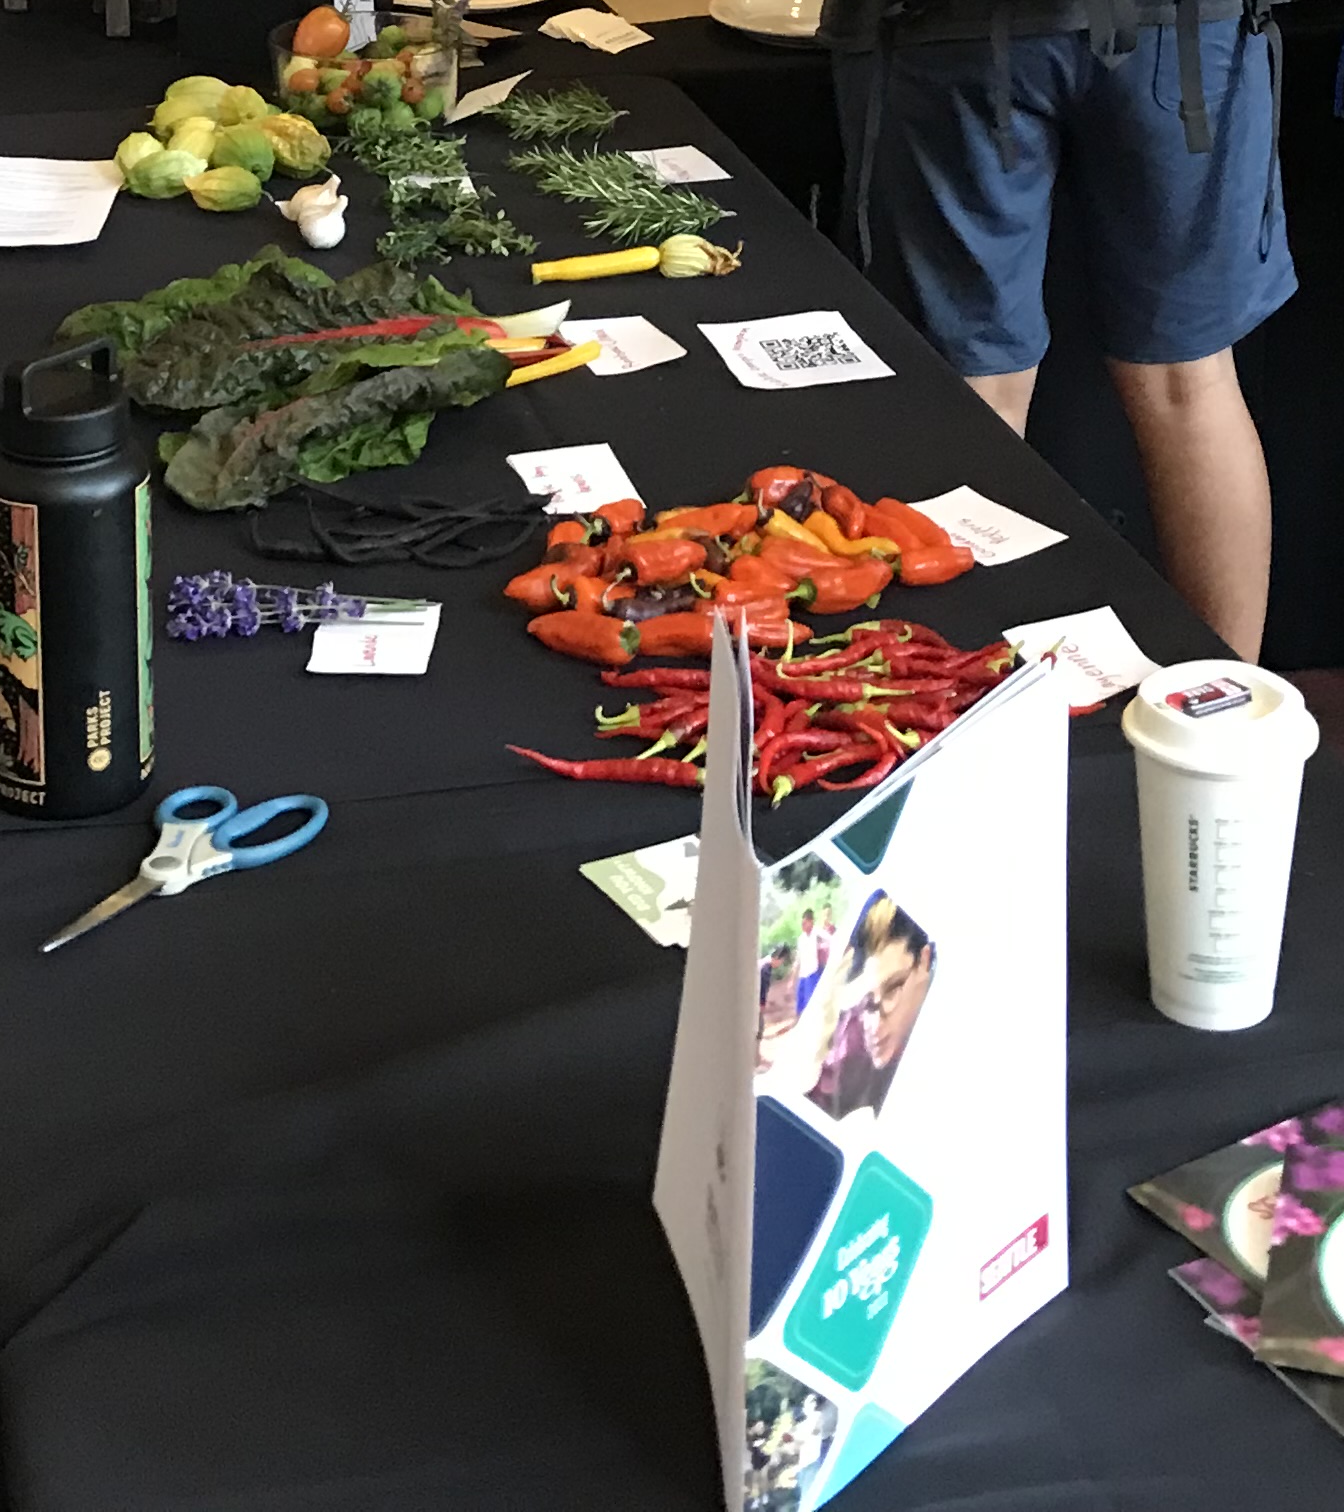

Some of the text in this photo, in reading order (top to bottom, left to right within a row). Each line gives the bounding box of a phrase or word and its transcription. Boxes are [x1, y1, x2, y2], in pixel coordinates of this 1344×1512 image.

[86, 706, 99, 748] PARKS
[99, 690, 112, 745] PROJECT
[1188, 818, 1199, 892] STARBUCKS
